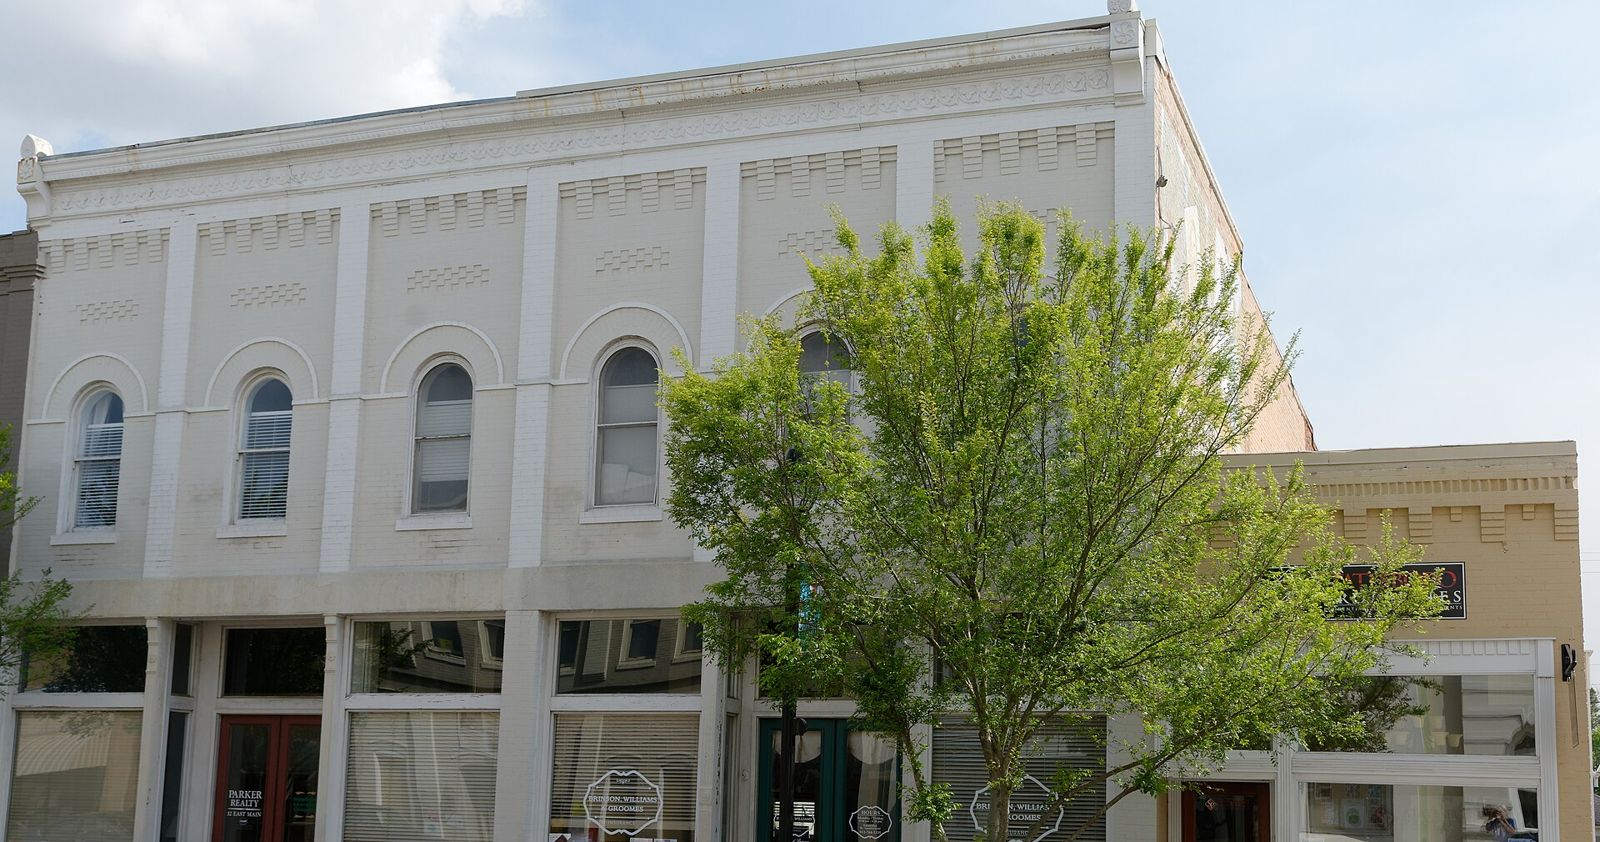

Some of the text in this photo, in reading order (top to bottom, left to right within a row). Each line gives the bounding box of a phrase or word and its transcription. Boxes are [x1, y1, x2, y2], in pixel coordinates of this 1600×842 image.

[229, 790, 262, 799] PARKER
[230, 799, 259, 807] REALTY
[976, 803, 1050, 811] BRIN, WILLIA
